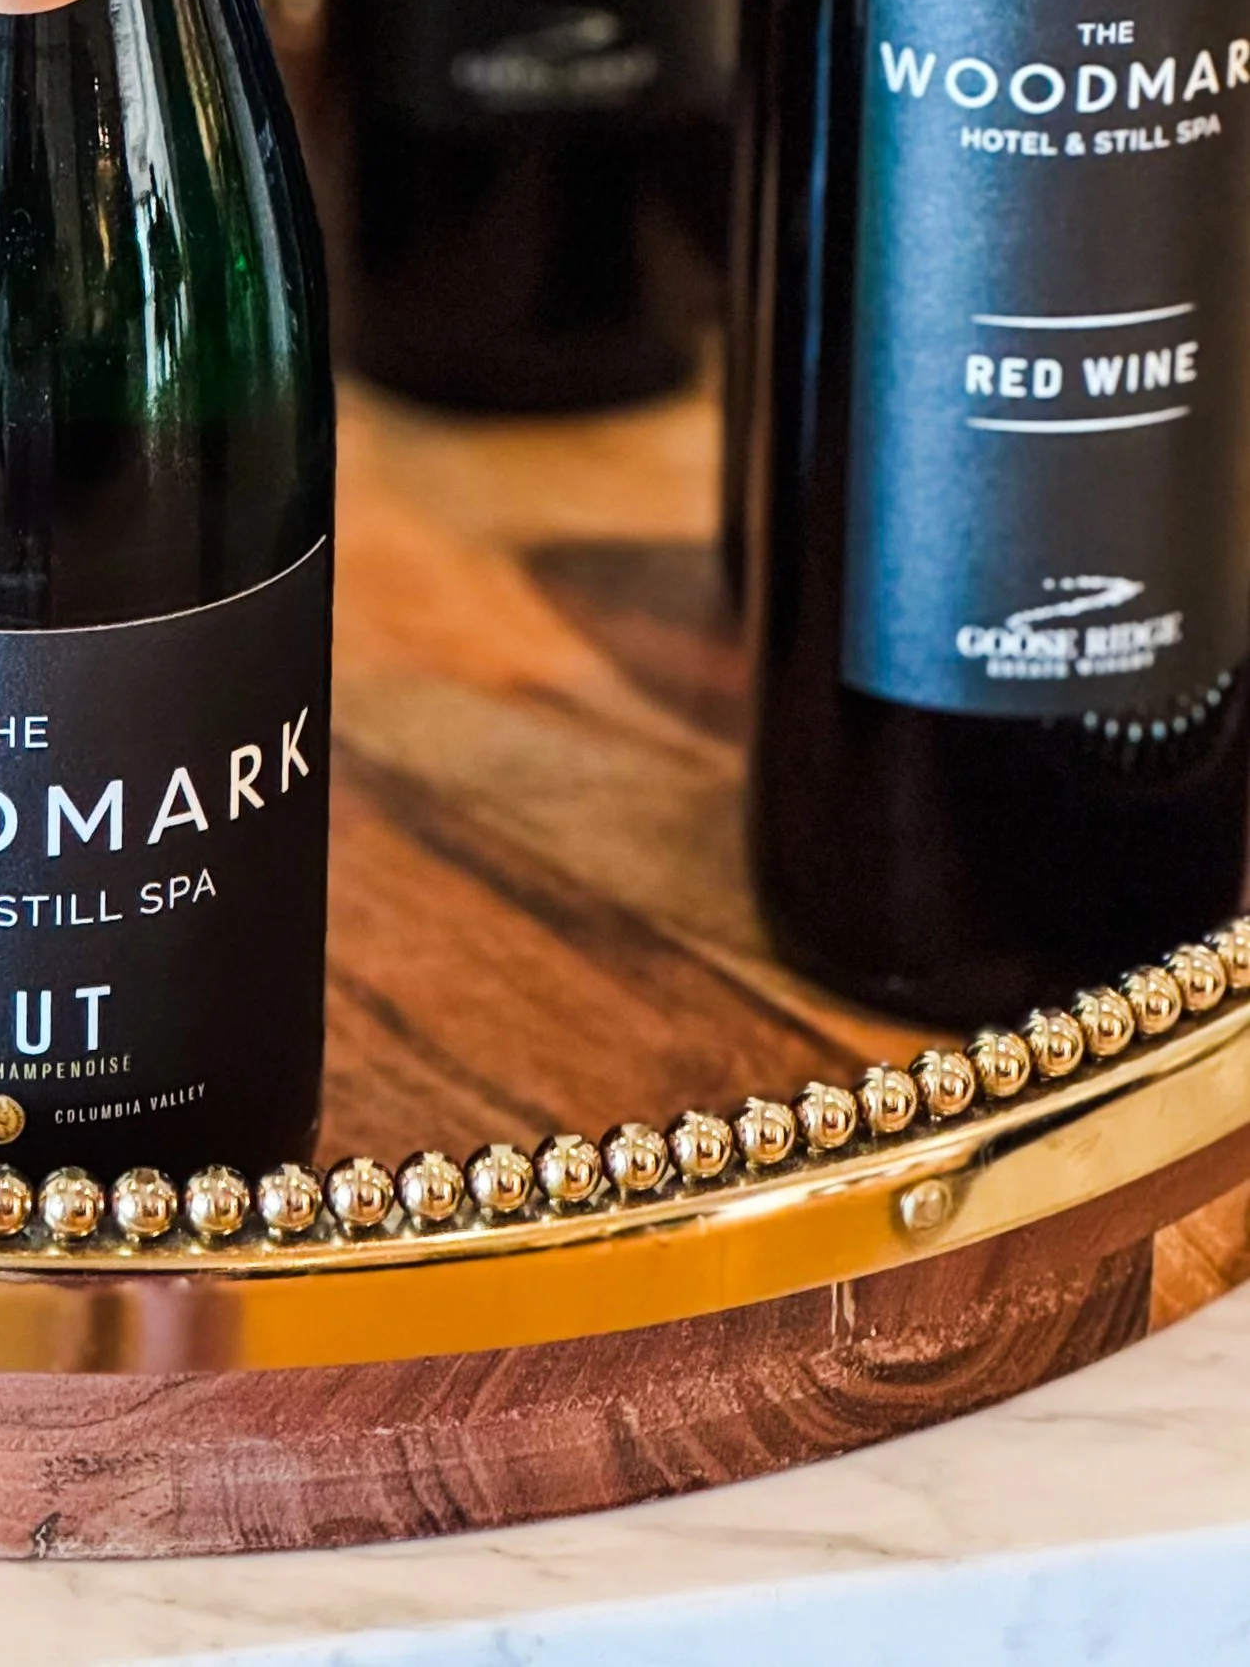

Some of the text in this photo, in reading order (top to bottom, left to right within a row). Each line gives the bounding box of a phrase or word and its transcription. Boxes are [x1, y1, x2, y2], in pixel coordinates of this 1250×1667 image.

[1077, 21, 1135, 46] THE
[961, 113, 1223, 157] HOTEL & STILL SPA
[965, 340, 1199, 400] RED WINE
[140, 867, 217, 916] SPA
[54, 1098, 142, 1125] COLUMBIA
[149, 1082, 207, 1112] VALLEY
